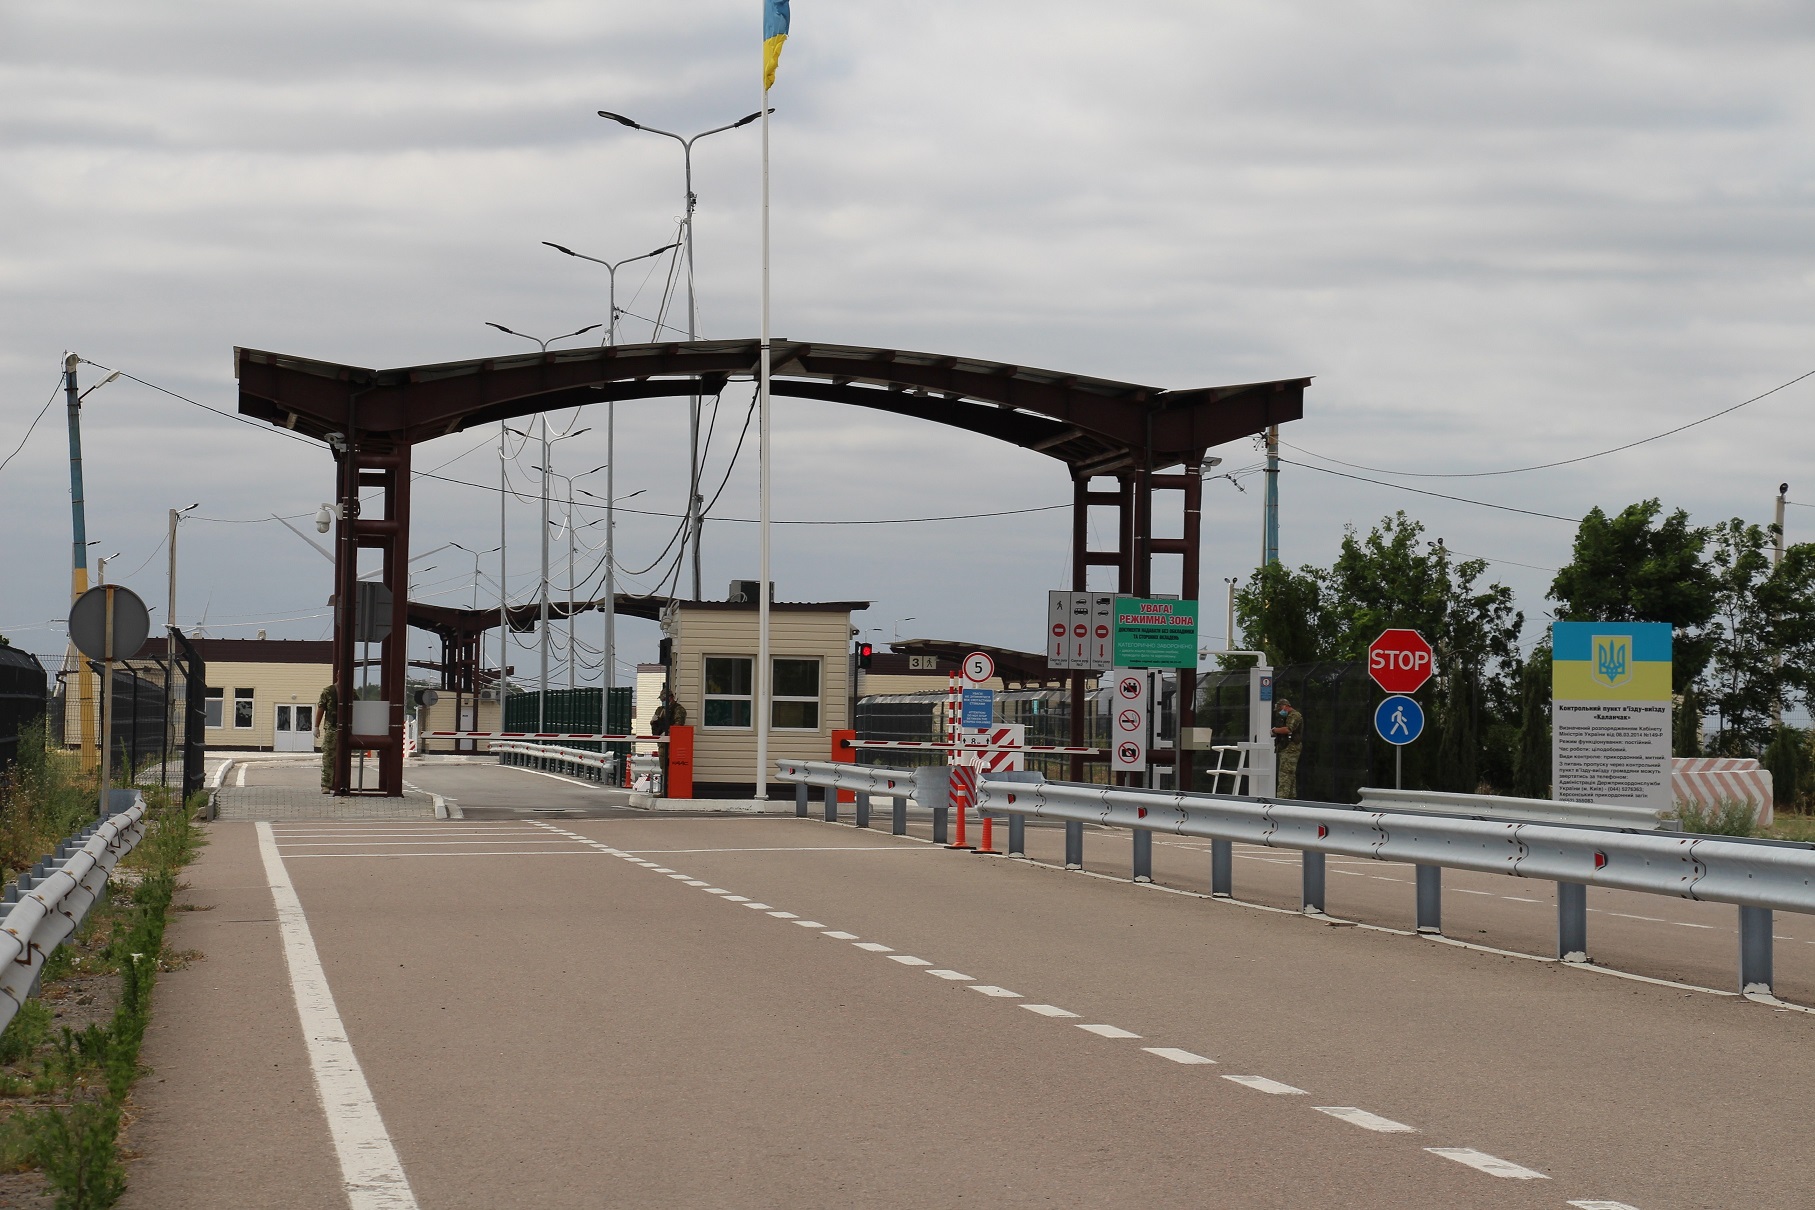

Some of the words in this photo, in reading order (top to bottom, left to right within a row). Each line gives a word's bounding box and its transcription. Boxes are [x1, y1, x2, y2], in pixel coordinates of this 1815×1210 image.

[1140, 603, 1173, 614] УВАГА!
[1119, 614, 1167, 625] РЕЖИМНА
[1169, 616, 1194, 626] ЗОНА
[912, 658, 920, 668] 3
[1371, 649, 1430, 671] STOP
[974, 661, 983, 674] 5
